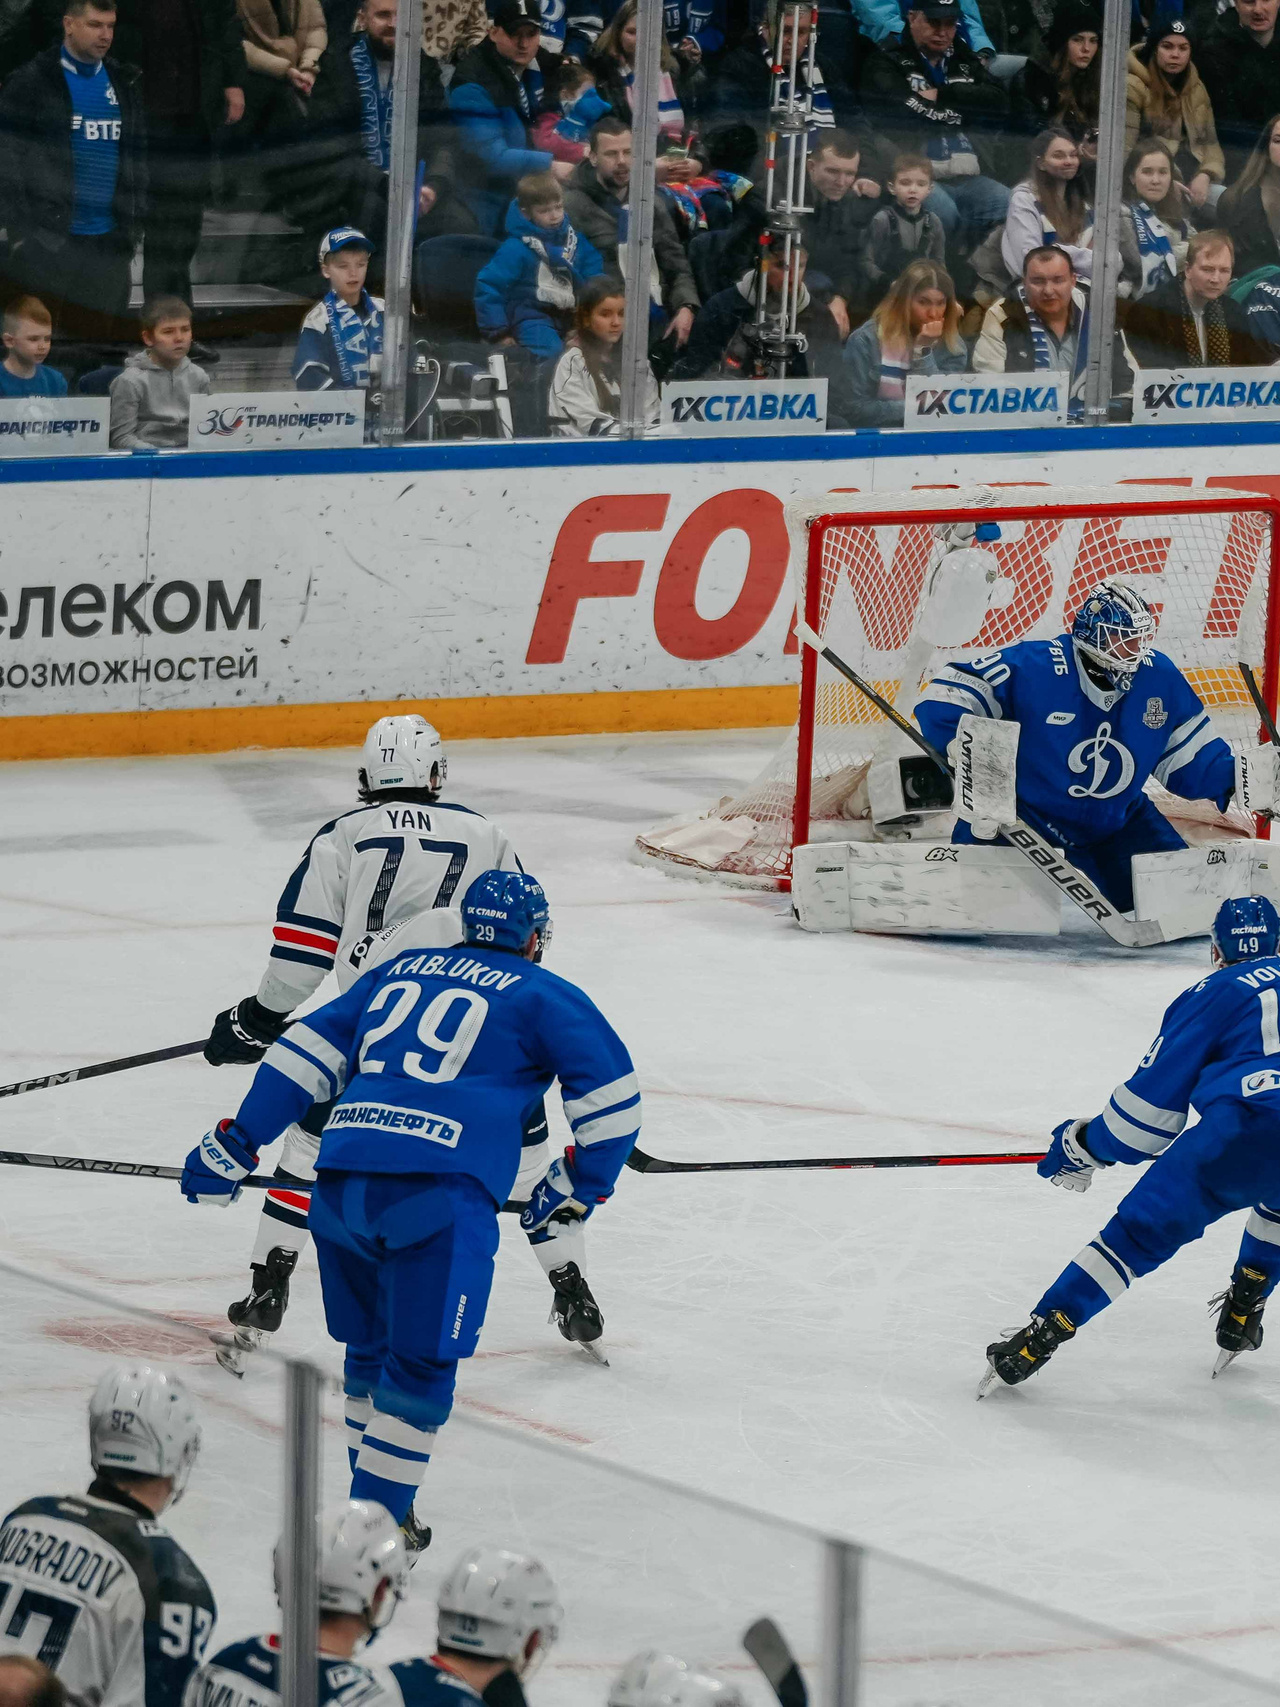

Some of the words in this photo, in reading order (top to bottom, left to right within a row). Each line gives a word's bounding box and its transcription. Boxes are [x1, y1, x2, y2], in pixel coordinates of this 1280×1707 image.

[85, 120, 122, 140] ВТБ
[246, 411, 356, 429] ТРАНСНЕФТЬ
[971, 652, 1011, 687] 90
[1048, 646, 1069, 676] ВТБ
[890, 710, 911, 729] MACH
[380, 748, 395, 762] 77
[386, 809, 432, 832] YAN
[354, 836, 469, 932] 77
[1009, 829, 1112, 922] BAUER
[476, 924, 496, 942] 29
[1238, 937, 1259, 954] 49
[387, 954, 522, 991] KABLUKOV
[358, 980, 490, 1084] 29
[331, 1107, 455, 1141] ТРАНСНЕФТЬ
[111, 1409, 135, 1433] 92
[159, 1602, 214, 1666] 92
